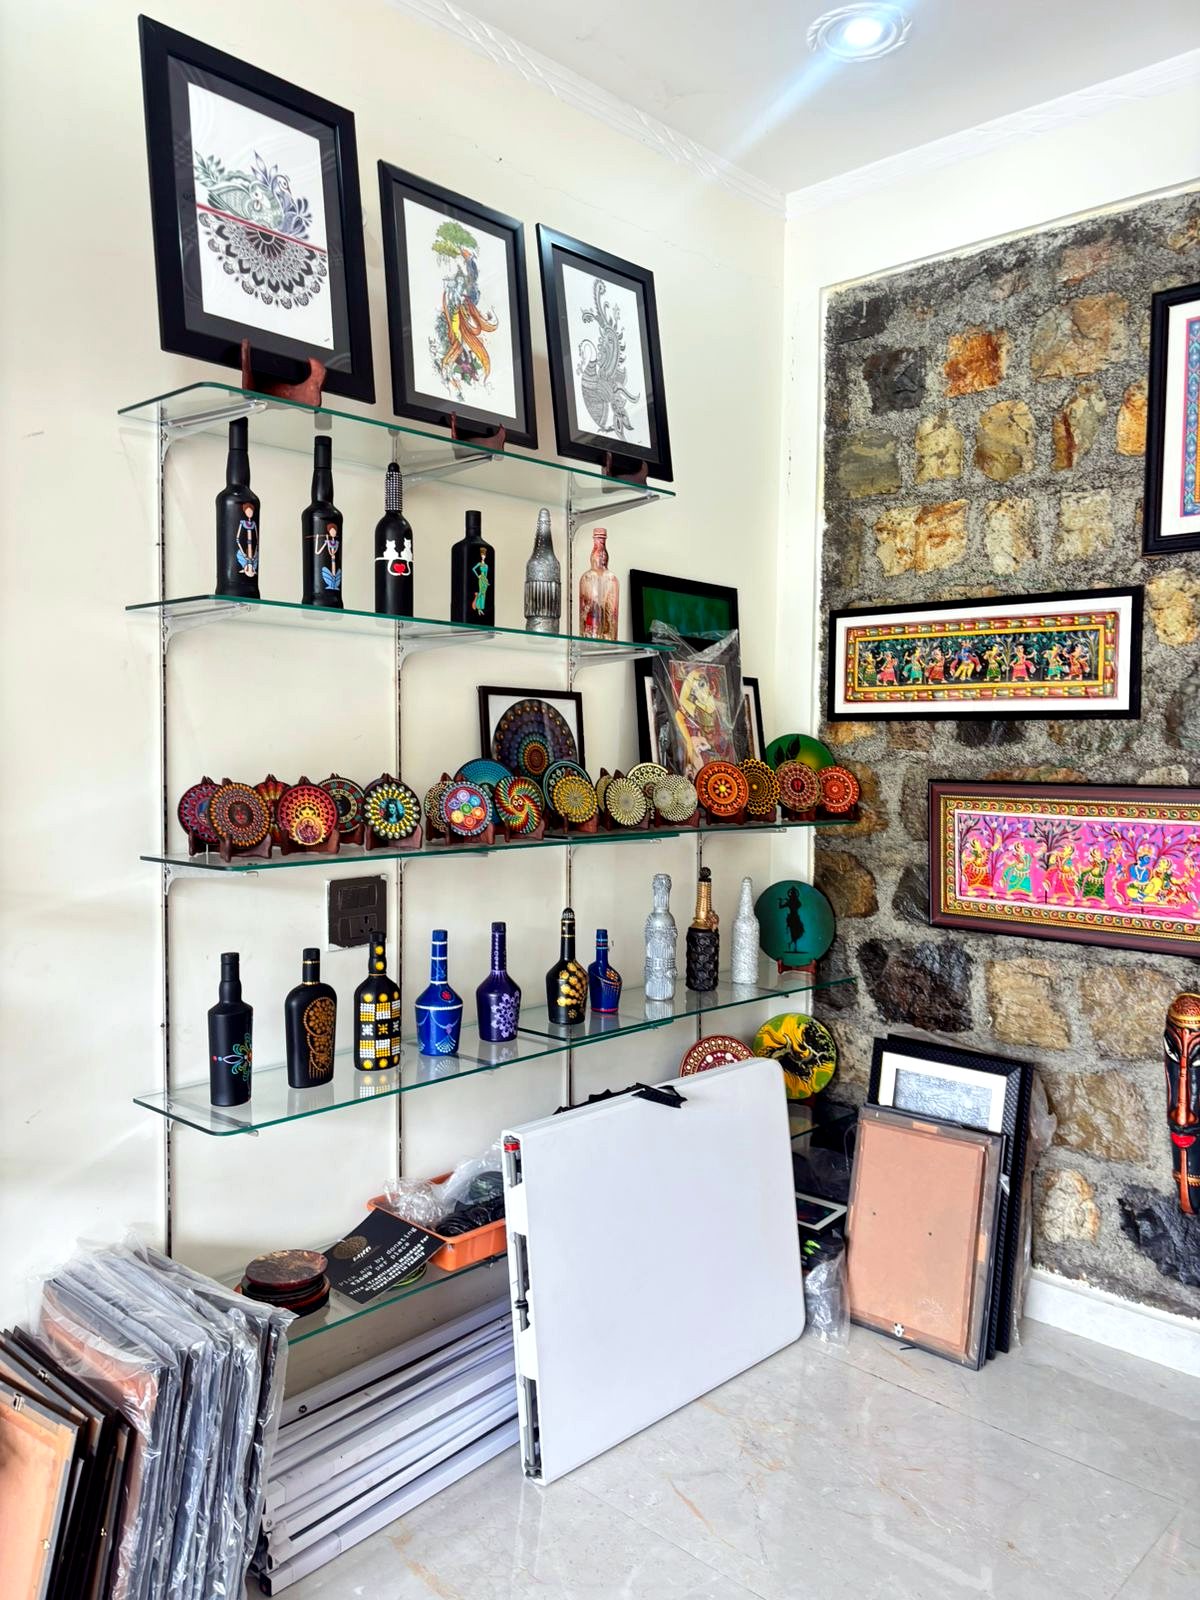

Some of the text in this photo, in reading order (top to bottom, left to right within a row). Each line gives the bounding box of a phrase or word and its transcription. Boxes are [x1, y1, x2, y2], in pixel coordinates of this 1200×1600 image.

[374, 1256, 385, 1264] by
[386, 1227, 417, 1255] donating
[390, 1242, 410, 1260] piece
